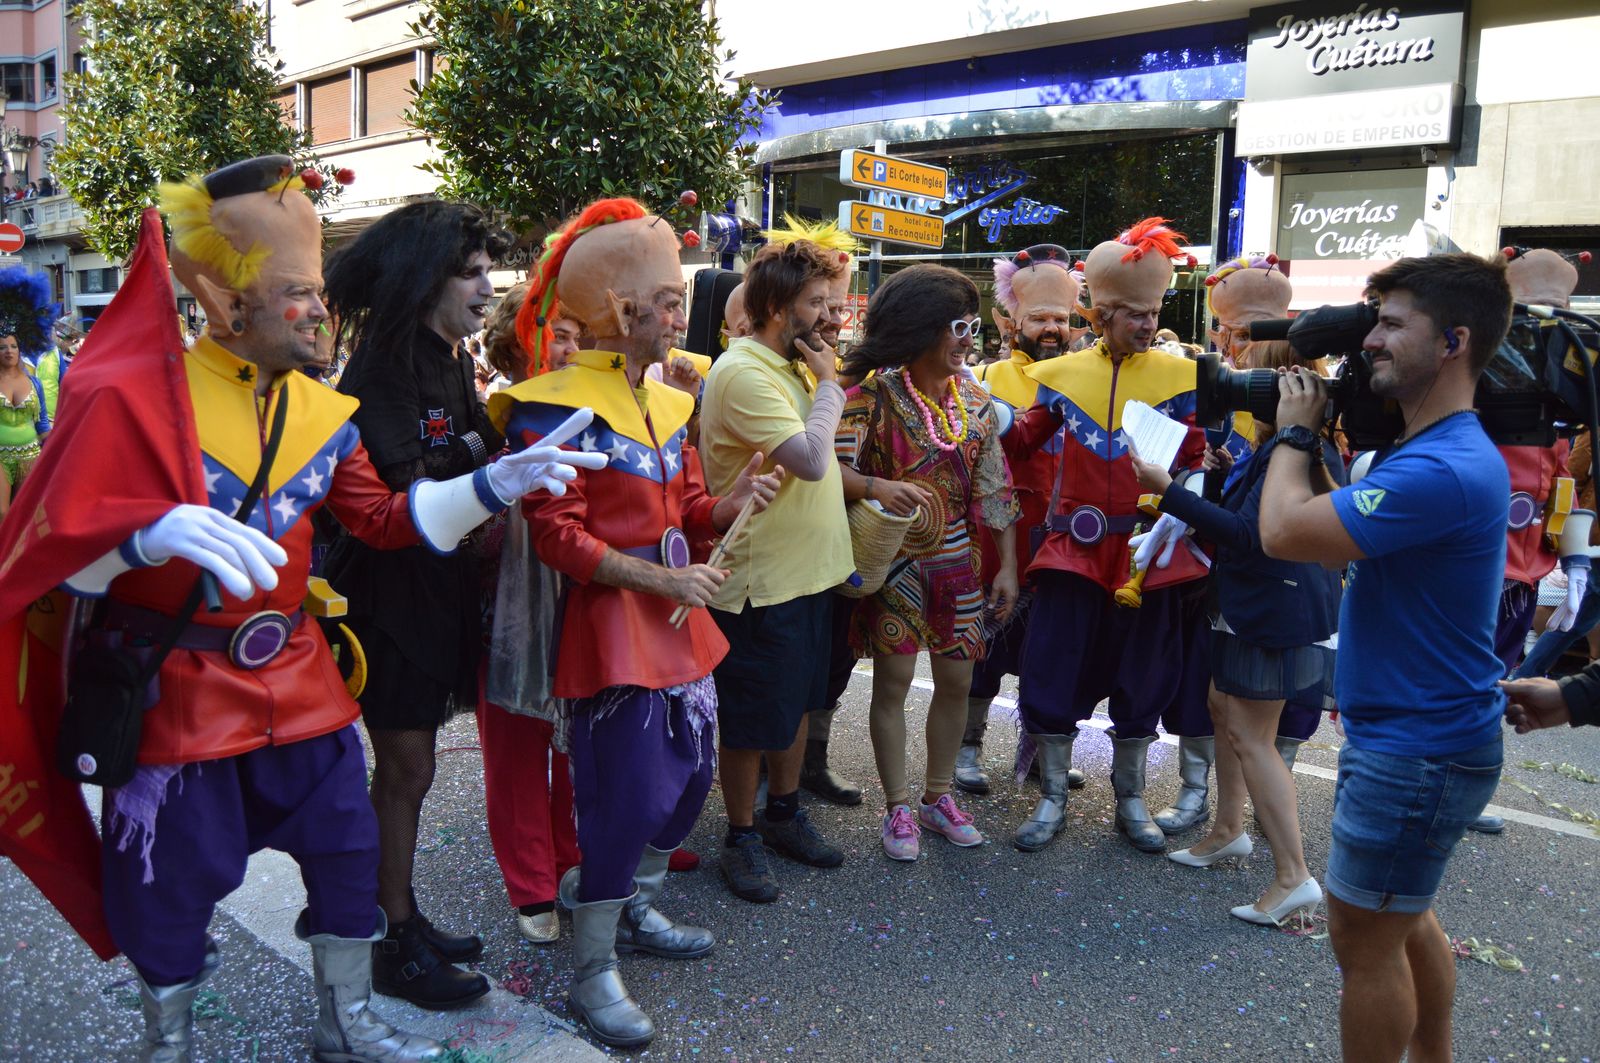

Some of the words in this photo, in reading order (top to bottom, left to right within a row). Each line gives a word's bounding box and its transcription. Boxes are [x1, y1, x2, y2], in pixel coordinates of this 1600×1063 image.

[1273, 3, 1400, 50] Joyerías
[1306, 36, 1434, 76] Cuétara
[1323, 130, 1345, 145] DE
[875, 162, 885, 180] P
[889, 167, 897, 179] El
[899, 169, 920, 184] Corte
[922, 172, 943, 189] Inglés
[904, 216, 921, 227] hotel
[923, 219, 931, 228] de
[933, 221, 940, 229] la
[1283, 199, 1399, 233] Joyerías
[888, 225, 939, 243] Reconquista
